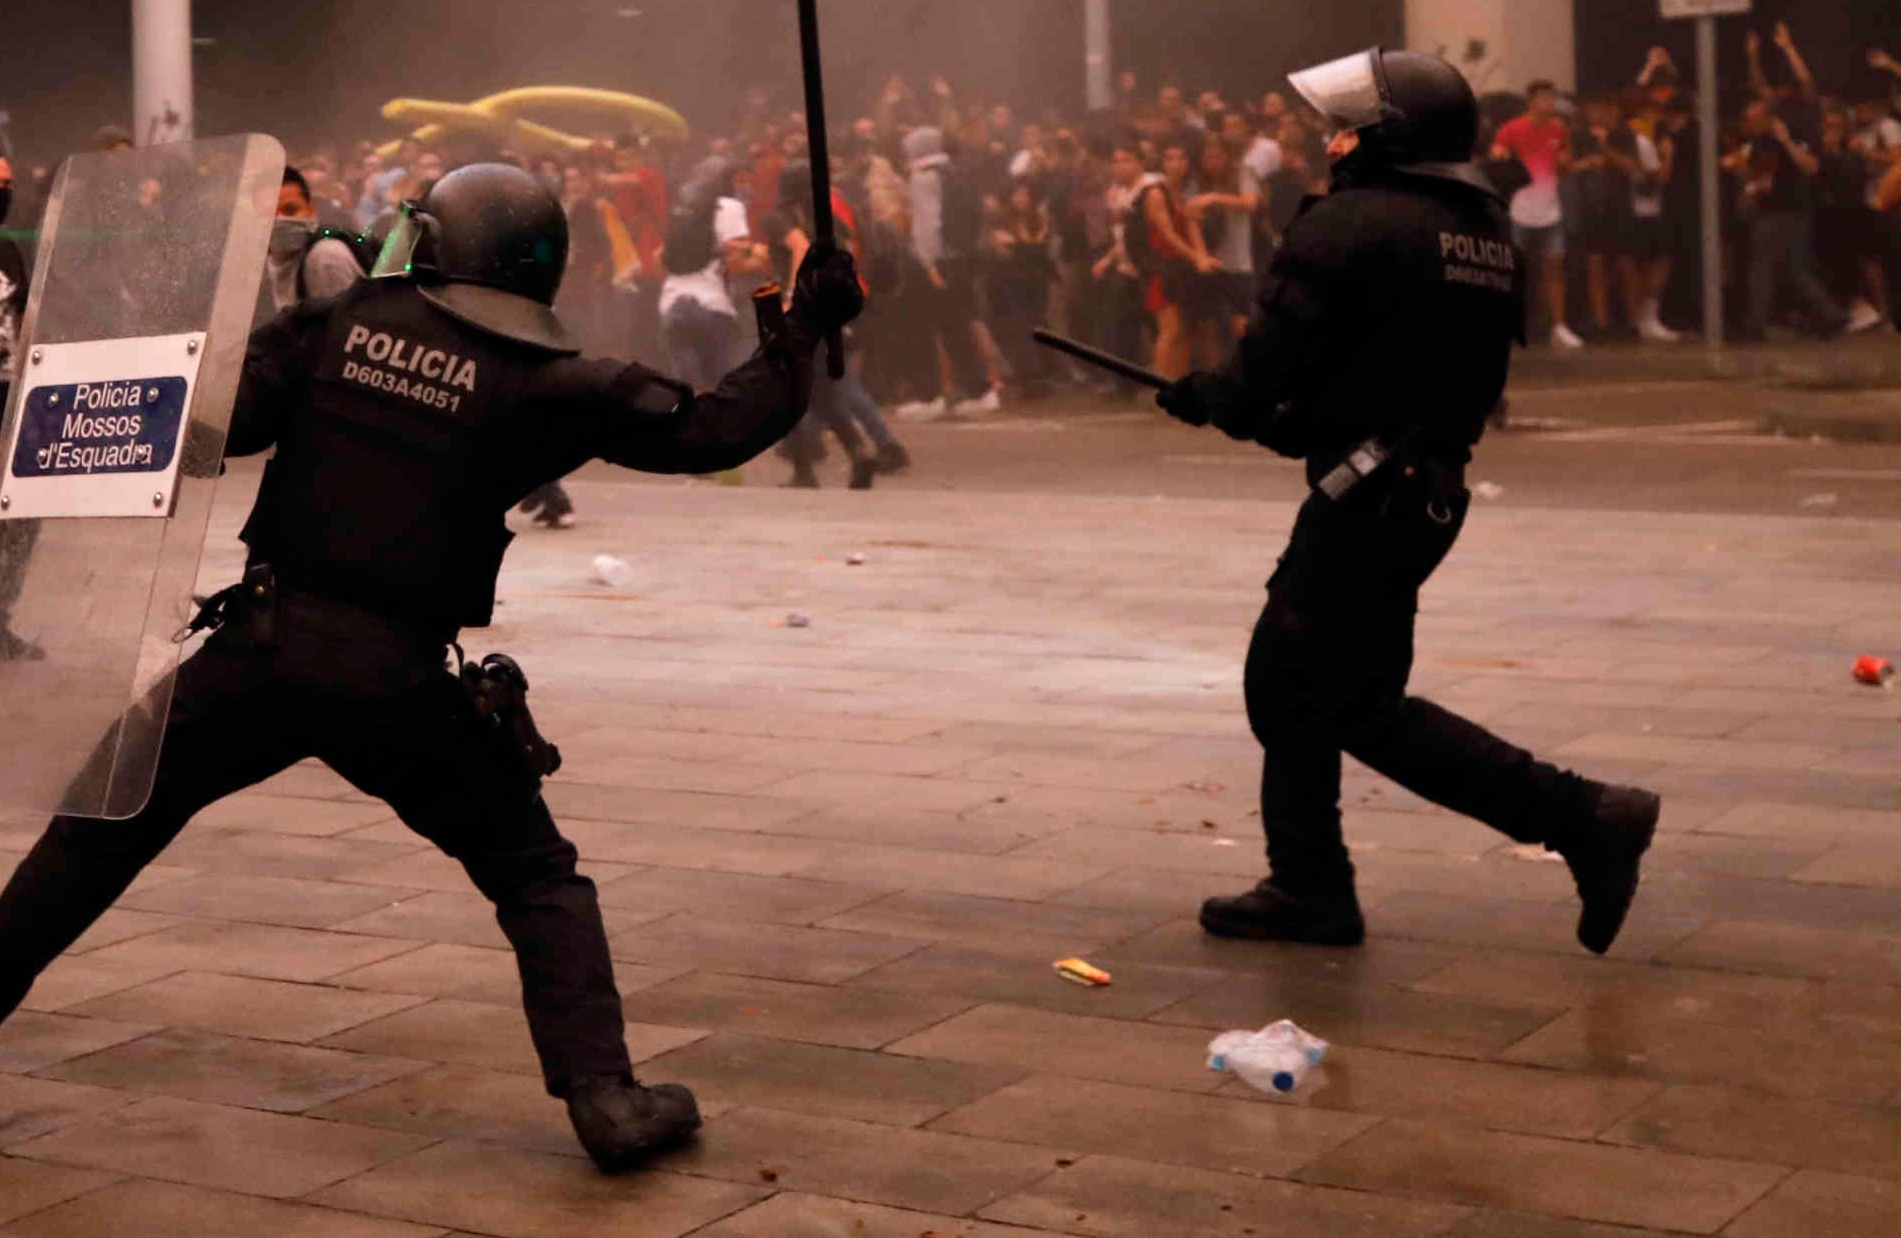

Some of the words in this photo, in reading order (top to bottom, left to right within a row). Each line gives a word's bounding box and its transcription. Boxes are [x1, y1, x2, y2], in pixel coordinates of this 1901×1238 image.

[1439, 231, 1514, 269] POLICIA
[344, 324, 477, 392] POLICIA
[342, 361, 461, 413] D603A4051
[62, 412, 141, 438] Mossos
